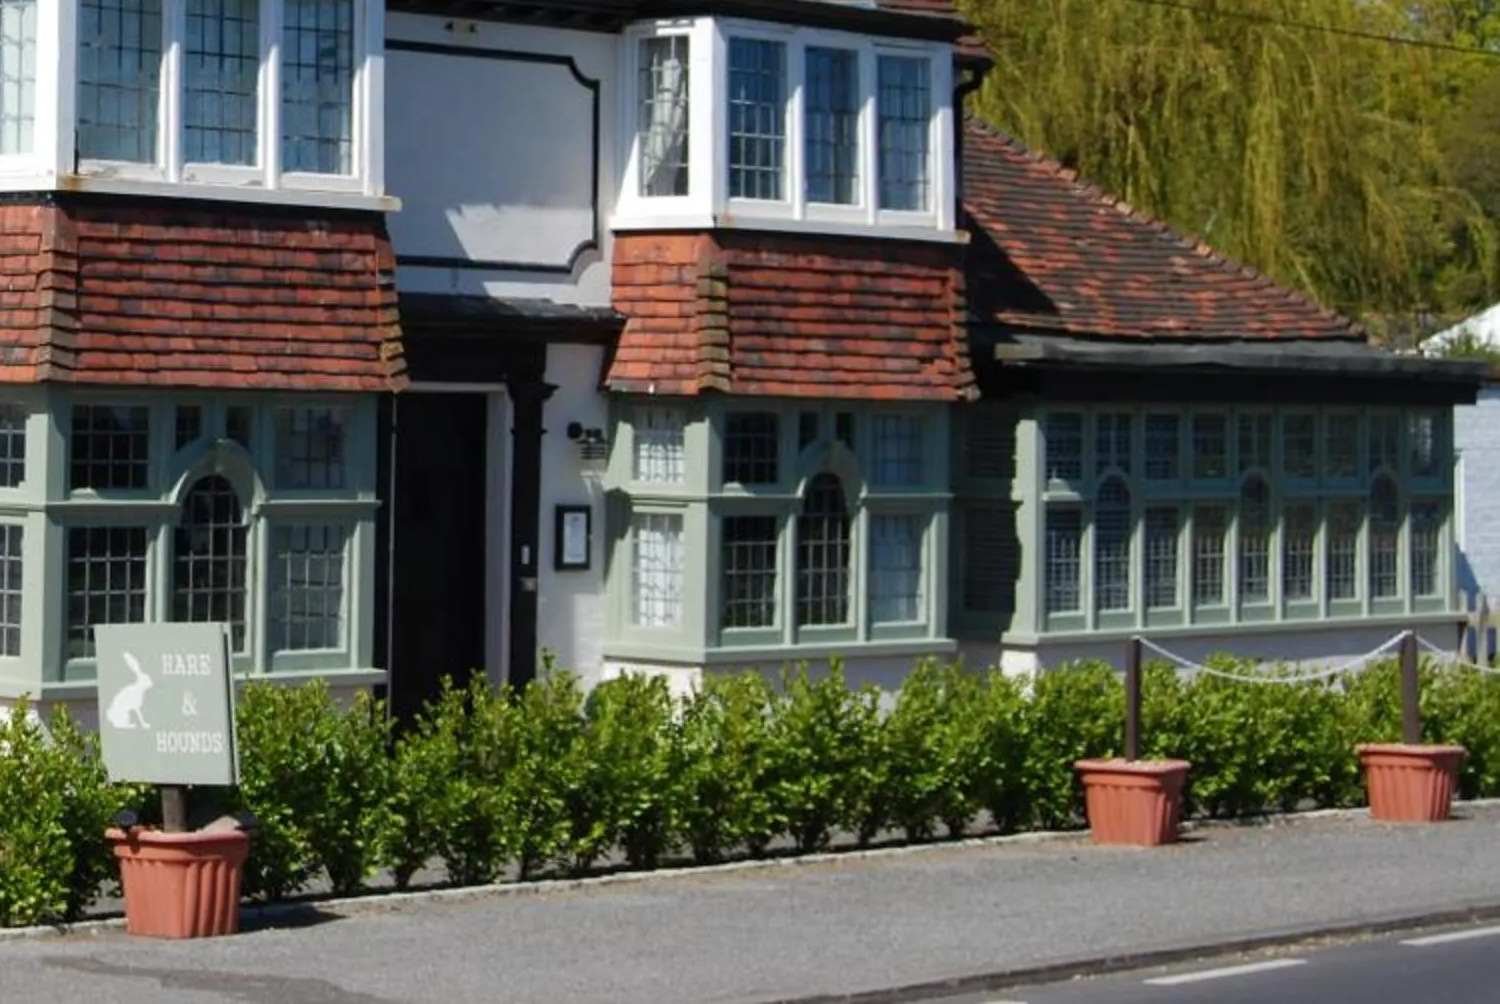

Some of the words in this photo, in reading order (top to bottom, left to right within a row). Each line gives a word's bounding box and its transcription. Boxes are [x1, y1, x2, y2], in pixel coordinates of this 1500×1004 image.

[161, 654, 211, 676] HARE
[181, 691, 197, 716] &
[156, 731, 223, 754] HOUNDS
